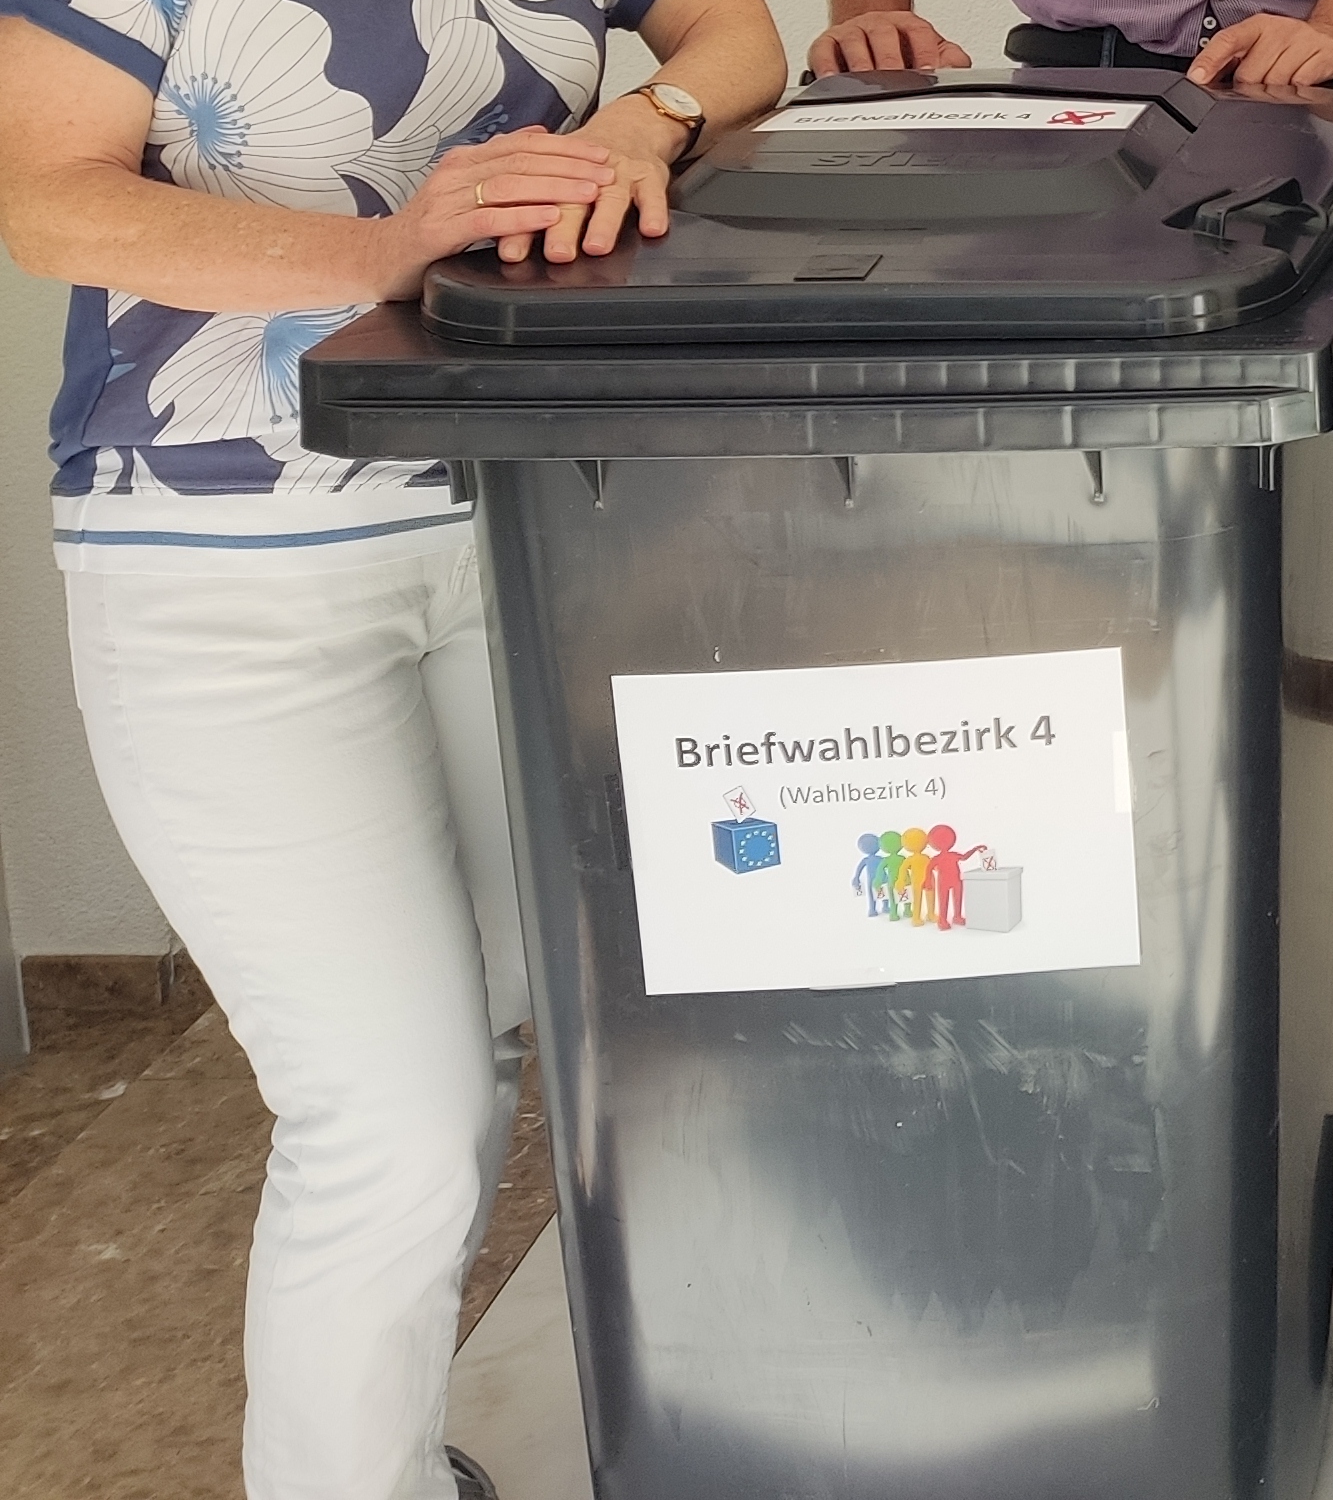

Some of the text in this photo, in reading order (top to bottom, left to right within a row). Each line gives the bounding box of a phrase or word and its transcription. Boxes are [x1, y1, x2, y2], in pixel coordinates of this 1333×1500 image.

[795, 111, 1033, 125] Briefwahlbezirk 4
[675, 714, 1057, 769] Briefwahlbezirk 4
[778, 776, 948, 810] (Wahlbezirk 4)
